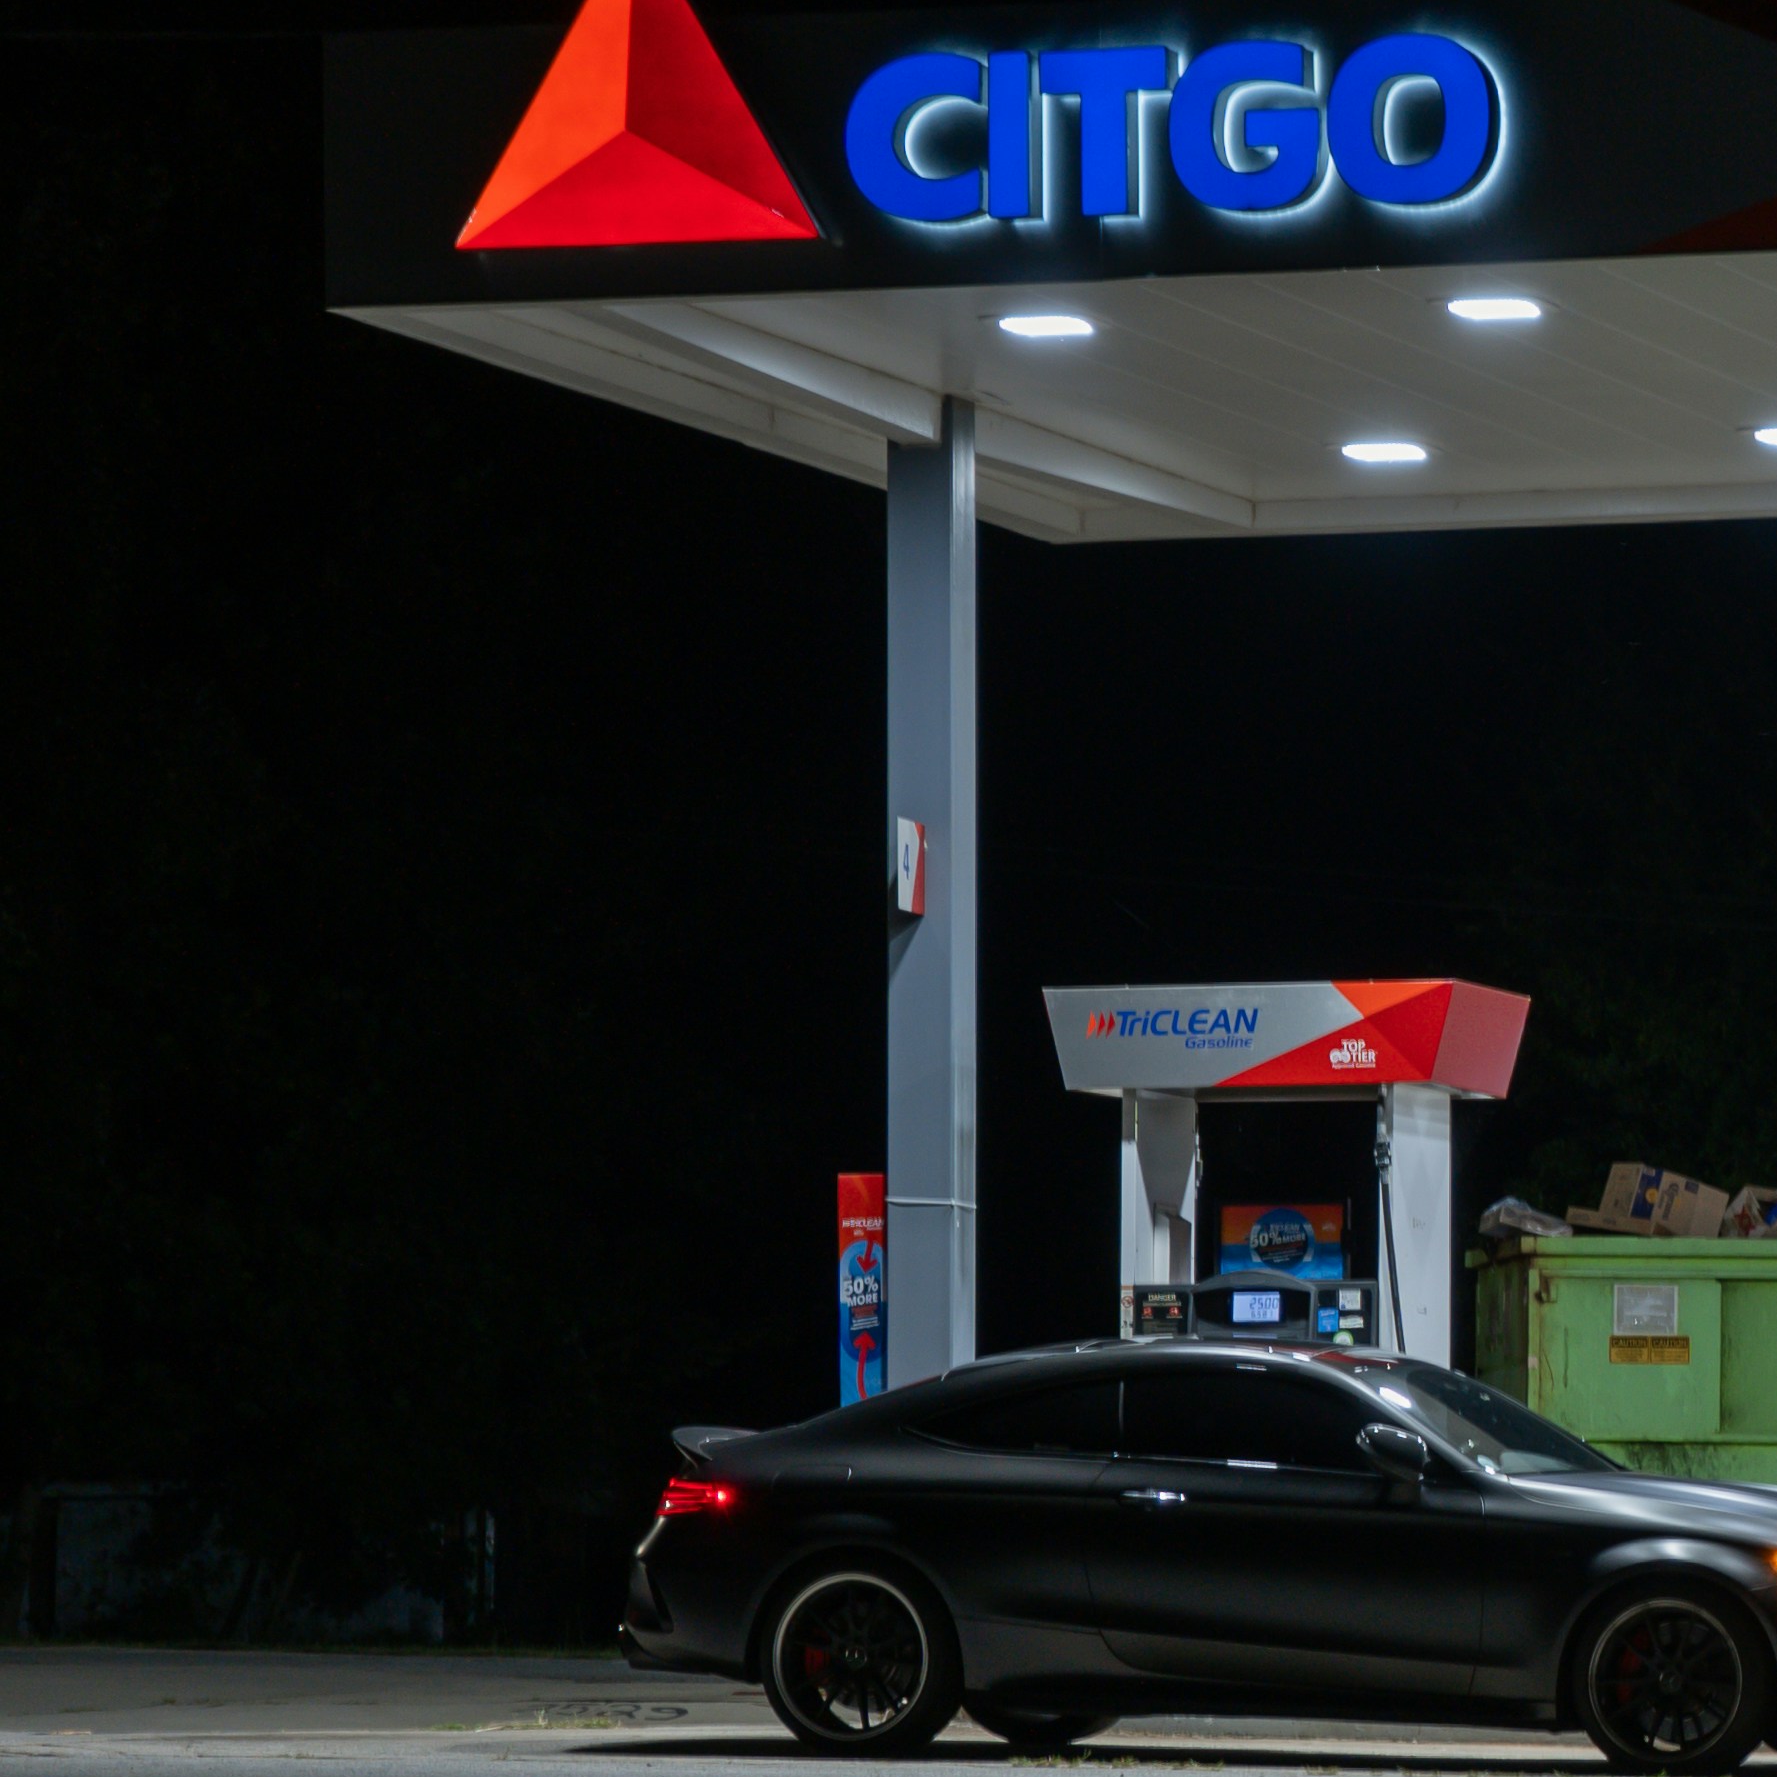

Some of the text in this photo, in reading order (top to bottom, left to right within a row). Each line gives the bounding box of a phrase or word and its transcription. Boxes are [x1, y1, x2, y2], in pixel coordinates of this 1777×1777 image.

[844, 31, 1501, 223] CITGO
[903, 843, 910, 880] 4
[1116, 1008, 1259, 1037] TriCLEAN
[1184, 1036, 1253, 1050] Gasoline
[1341, 1038, 1366, 1052] TOP
[1351, 1049, 1377, 1063] TIER
[843, 1275, 879, 1296] 50%
[847, 1292, 879, 1307] MORE
